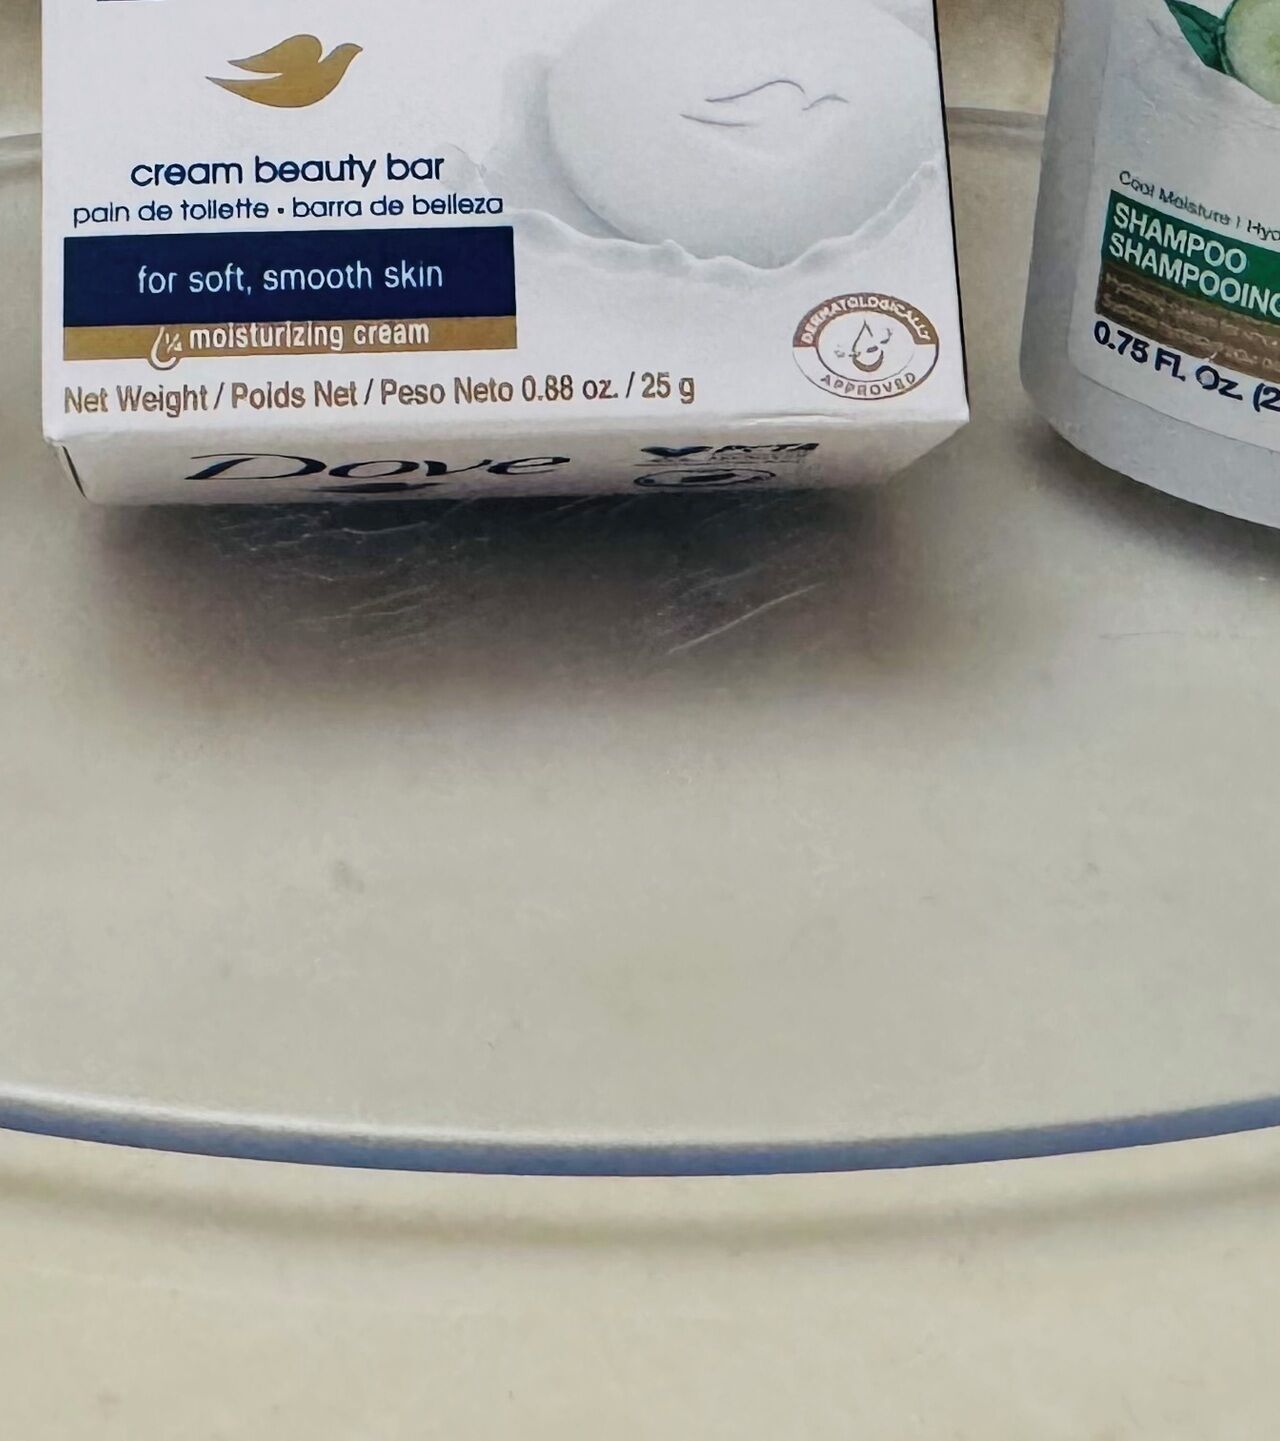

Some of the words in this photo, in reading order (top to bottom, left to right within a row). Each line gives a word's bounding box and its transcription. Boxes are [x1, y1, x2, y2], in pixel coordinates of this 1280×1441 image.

[131, 163, 243, 186] cream
[255, 154, 376, 187] beauty
[387, 152, 444, 180] bar
[73, 201, 130, 228] pain
[138, 200, 173, 221] de
[180, 198, 269, 221] toilette
[293, 197, 362, 217] barra
[370, 195, 404, 215] de
[412, 193, 503, 215] belleza
[1119, 170, 1155, 197] Cool
[1159, 187, 1231, 225] Moisture
[1113, 202, 1248, 273] SHAMPOO
[138, 264, 177, 294] for
[188, 262, 252, 296] soft,
[263, 259, 372, 290] smooth
[384, 259, 443, 288] skin
[189, 320, 344, 352] moisturizing
[353, 322, 430, 346] cream
[1094, 320, 1148, 363] 0.75
[64, 386, 108, 414] Net
[116, 384, 208, 418] Weight
[213, 381, 225, 410] /
[231, 380, 306, 409] Poids
[314, 379, 358, 408] Net
[363, 377, 374, 405] /
[380, 378, 446, 405] Peso
[453, 376, 514, 404] Neto
[522, 375, 573, 402] 0.88
[582, 378, 619, 400] oz.
[625, 370, 635, 399] /
[641, 371, 670, 399] 25
[679, 377, 695, 404] g
[820, 372, 916, 396] APPROVED
[184, 453, 570, 480] Dove
